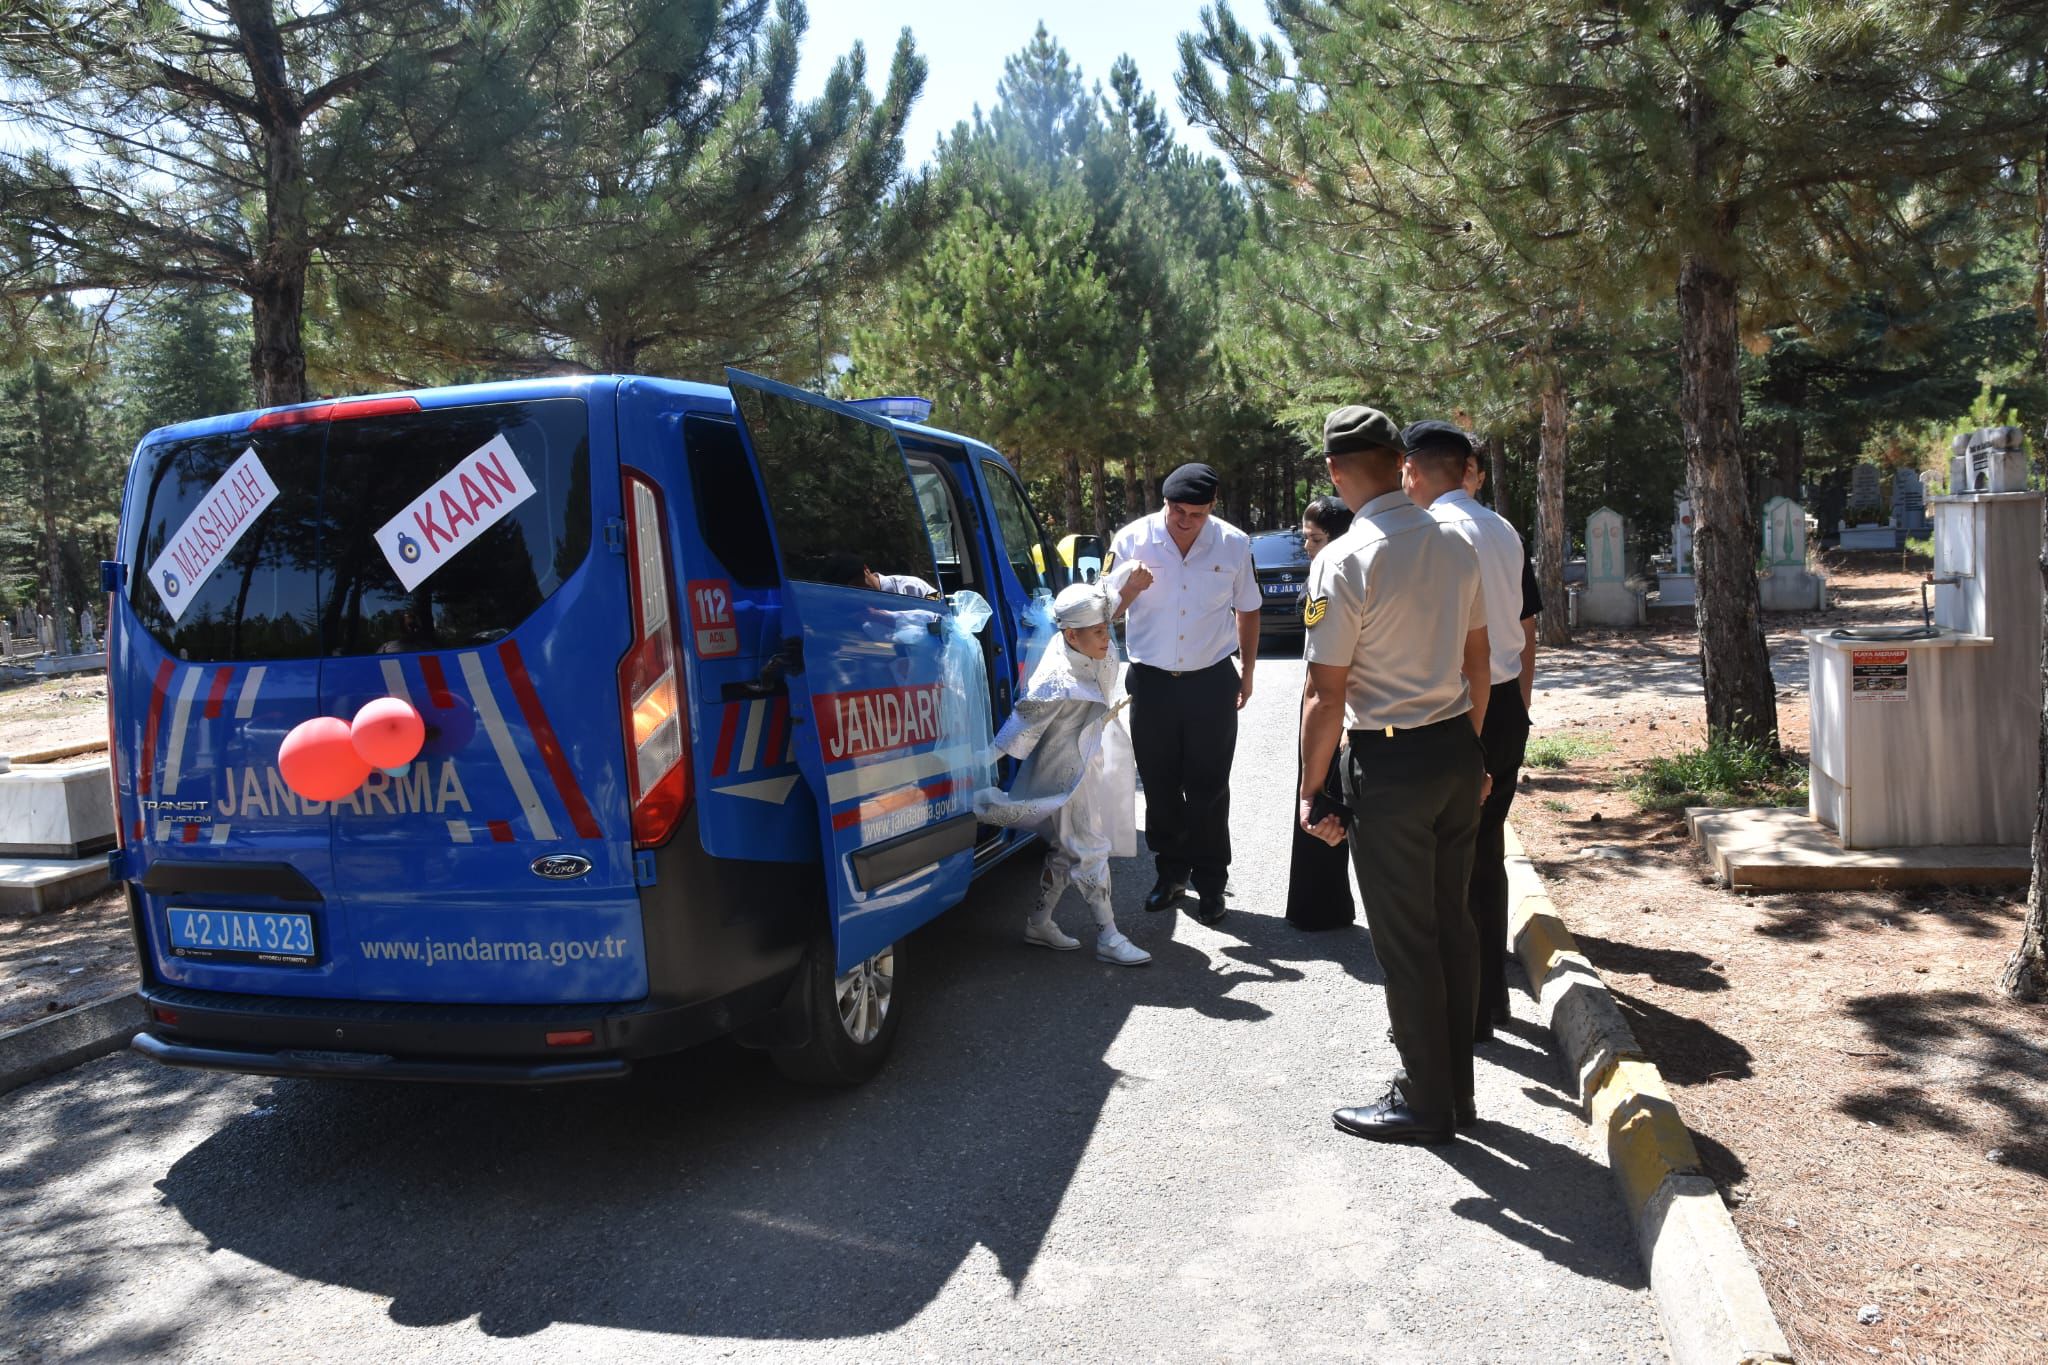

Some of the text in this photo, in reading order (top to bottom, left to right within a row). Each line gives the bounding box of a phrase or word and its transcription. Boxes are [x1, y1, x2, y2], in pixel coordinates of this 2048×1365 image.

[413, 451, 516, 554] KAAN
[1268, 584, 1278, 593] 42
[695, 588, 730, 624] 112
[141, 800, 209, 810] TRANSIT
[162, 815, 212, 823] CUSTOM
[544, 859, 577, 874] Ford
[184, 913, 310, 951] 42 JAA 323
[360, 934, 628, 967] www.jandarma.gov.tr
